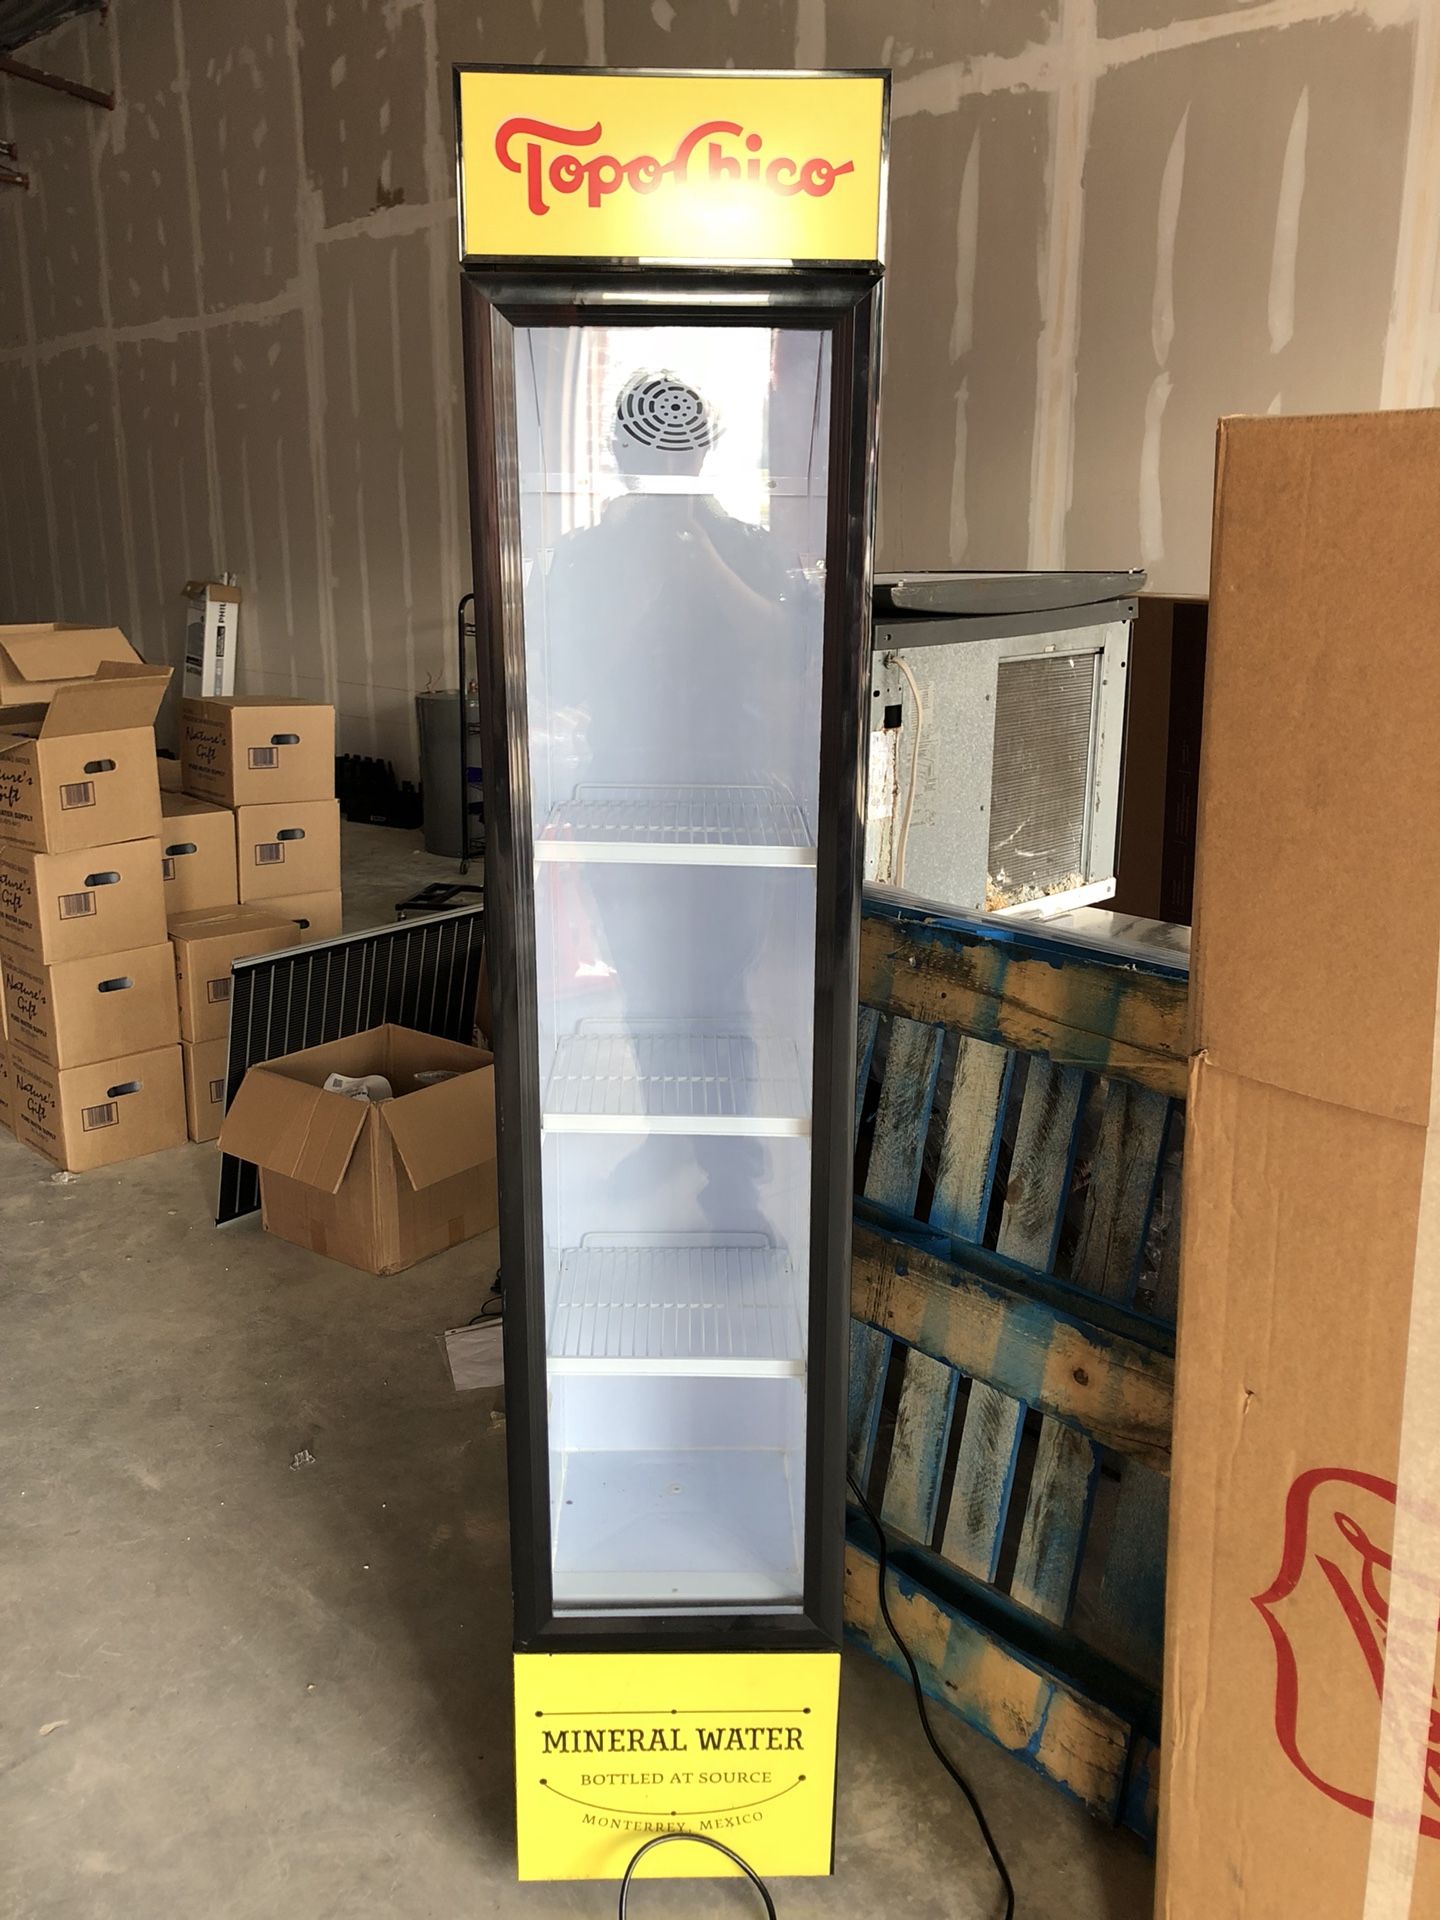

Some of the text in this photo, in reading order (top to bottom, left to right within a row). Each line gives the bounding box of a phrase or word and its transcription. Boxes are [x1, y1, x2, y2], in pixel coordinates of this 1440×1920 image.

[495, 117, 855, 215] Topo Chico
[1, 888, 23, 913] Gift
[6, 973, 46, 1005] Nature's
[17, 996, 37, 1020] Gift
[16, 1075, 55, 1108] Nature's
[542, 1727, 804, 1754] MINERAL WATER
[580, 1771, 772, 1786] BOTTLED AT SOURCE
[699, 1811, 764, 1831] MEXICO
